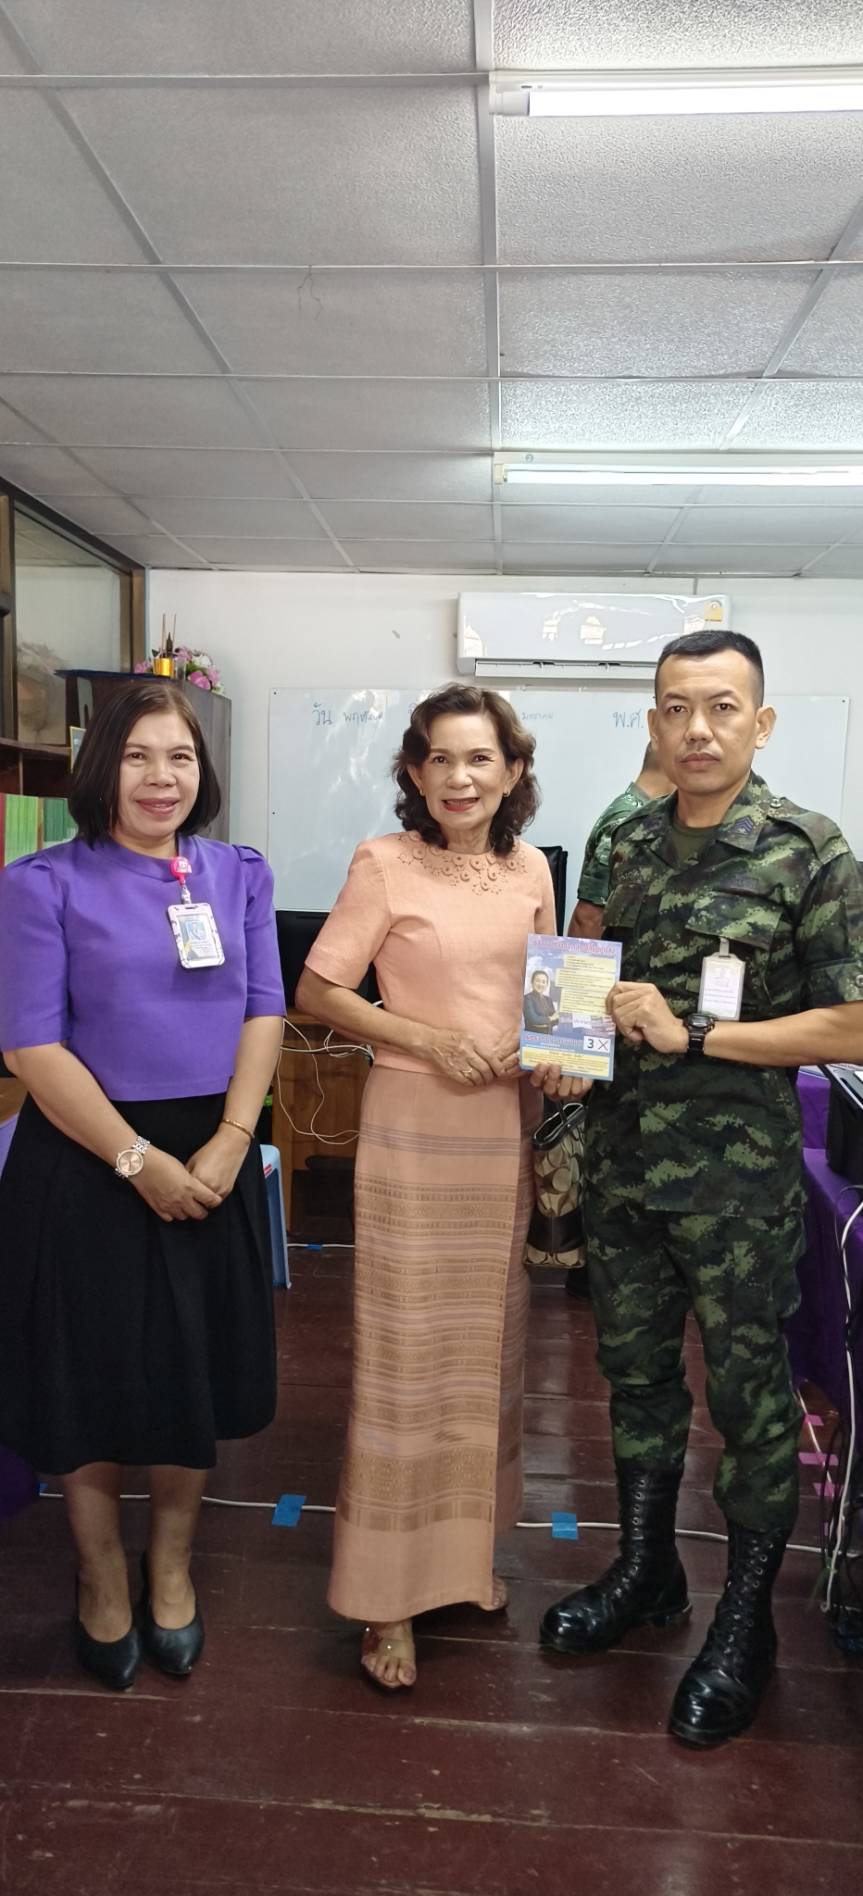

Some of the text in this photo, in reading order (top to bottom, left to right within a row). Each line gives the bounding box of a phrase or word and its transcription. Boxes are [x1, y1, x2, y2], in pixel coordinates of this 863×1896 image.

[312, 702, 333, 726] วัน
[612, 707, 645, 729] พ.ศ.
[586, 1038, 595, 1049] 3
